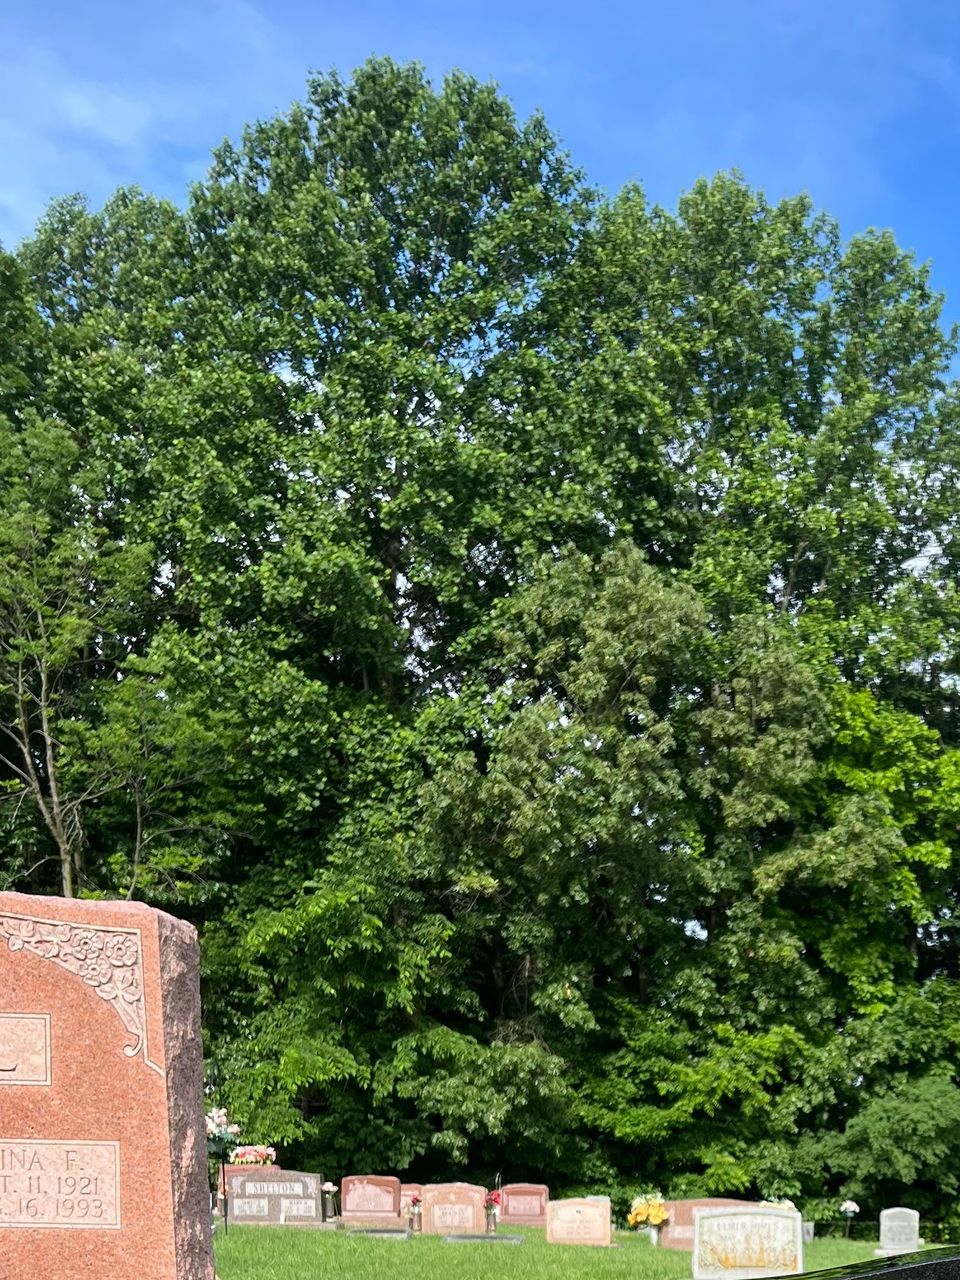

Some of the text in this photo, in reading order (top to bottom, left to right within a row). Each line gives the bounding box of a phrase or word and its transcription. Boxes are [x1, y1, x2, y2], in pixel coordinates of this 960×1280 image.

[65, 1151, 84, 1171] F.
[28, 1176, 47, 1195] 11,
[57, 1177, 98, 1195] 1921
[56, 1199, 103, 1218] 1993
